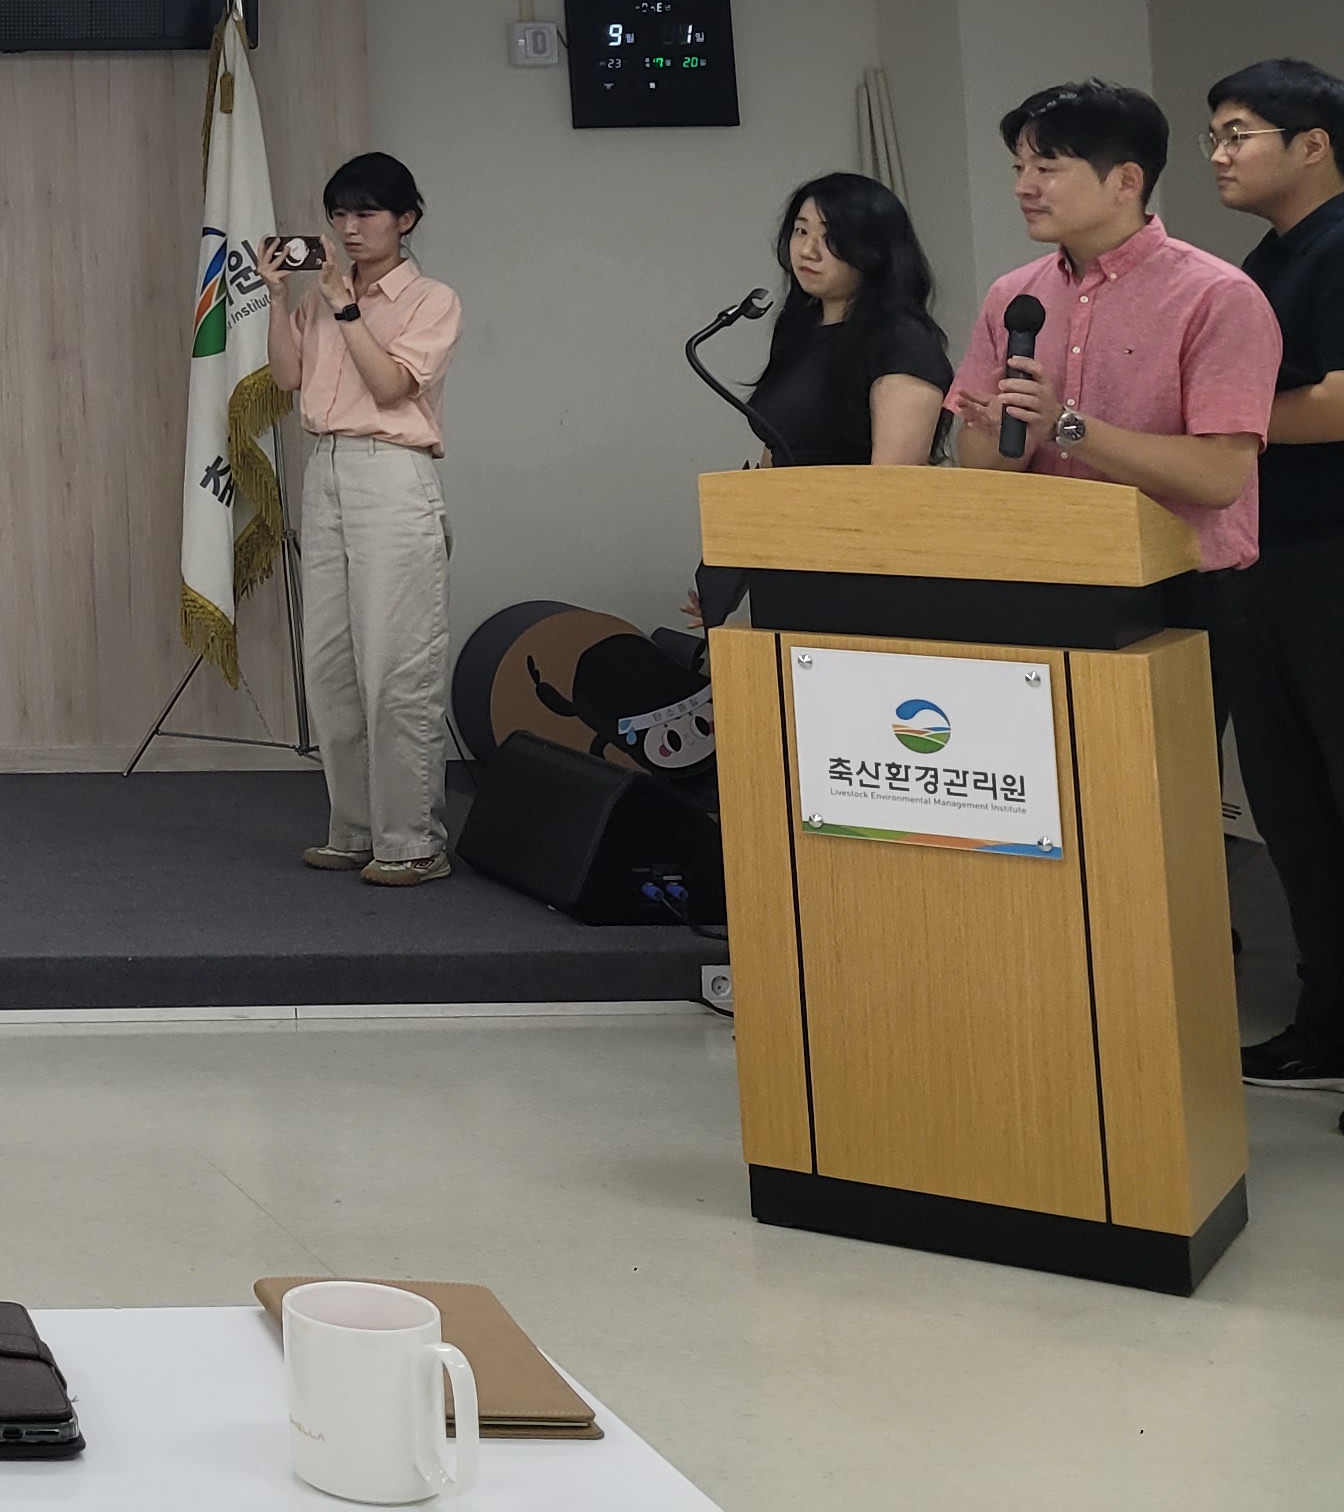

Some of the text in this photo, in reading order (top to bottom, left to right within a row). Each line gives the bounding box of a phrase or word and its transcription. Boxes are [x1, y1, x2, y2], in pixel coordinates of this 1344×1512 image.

[828, 756, 1027, 803] 축산환경관리원
[830, 787, 1027, 815] Livestock Environmental Management Institute
